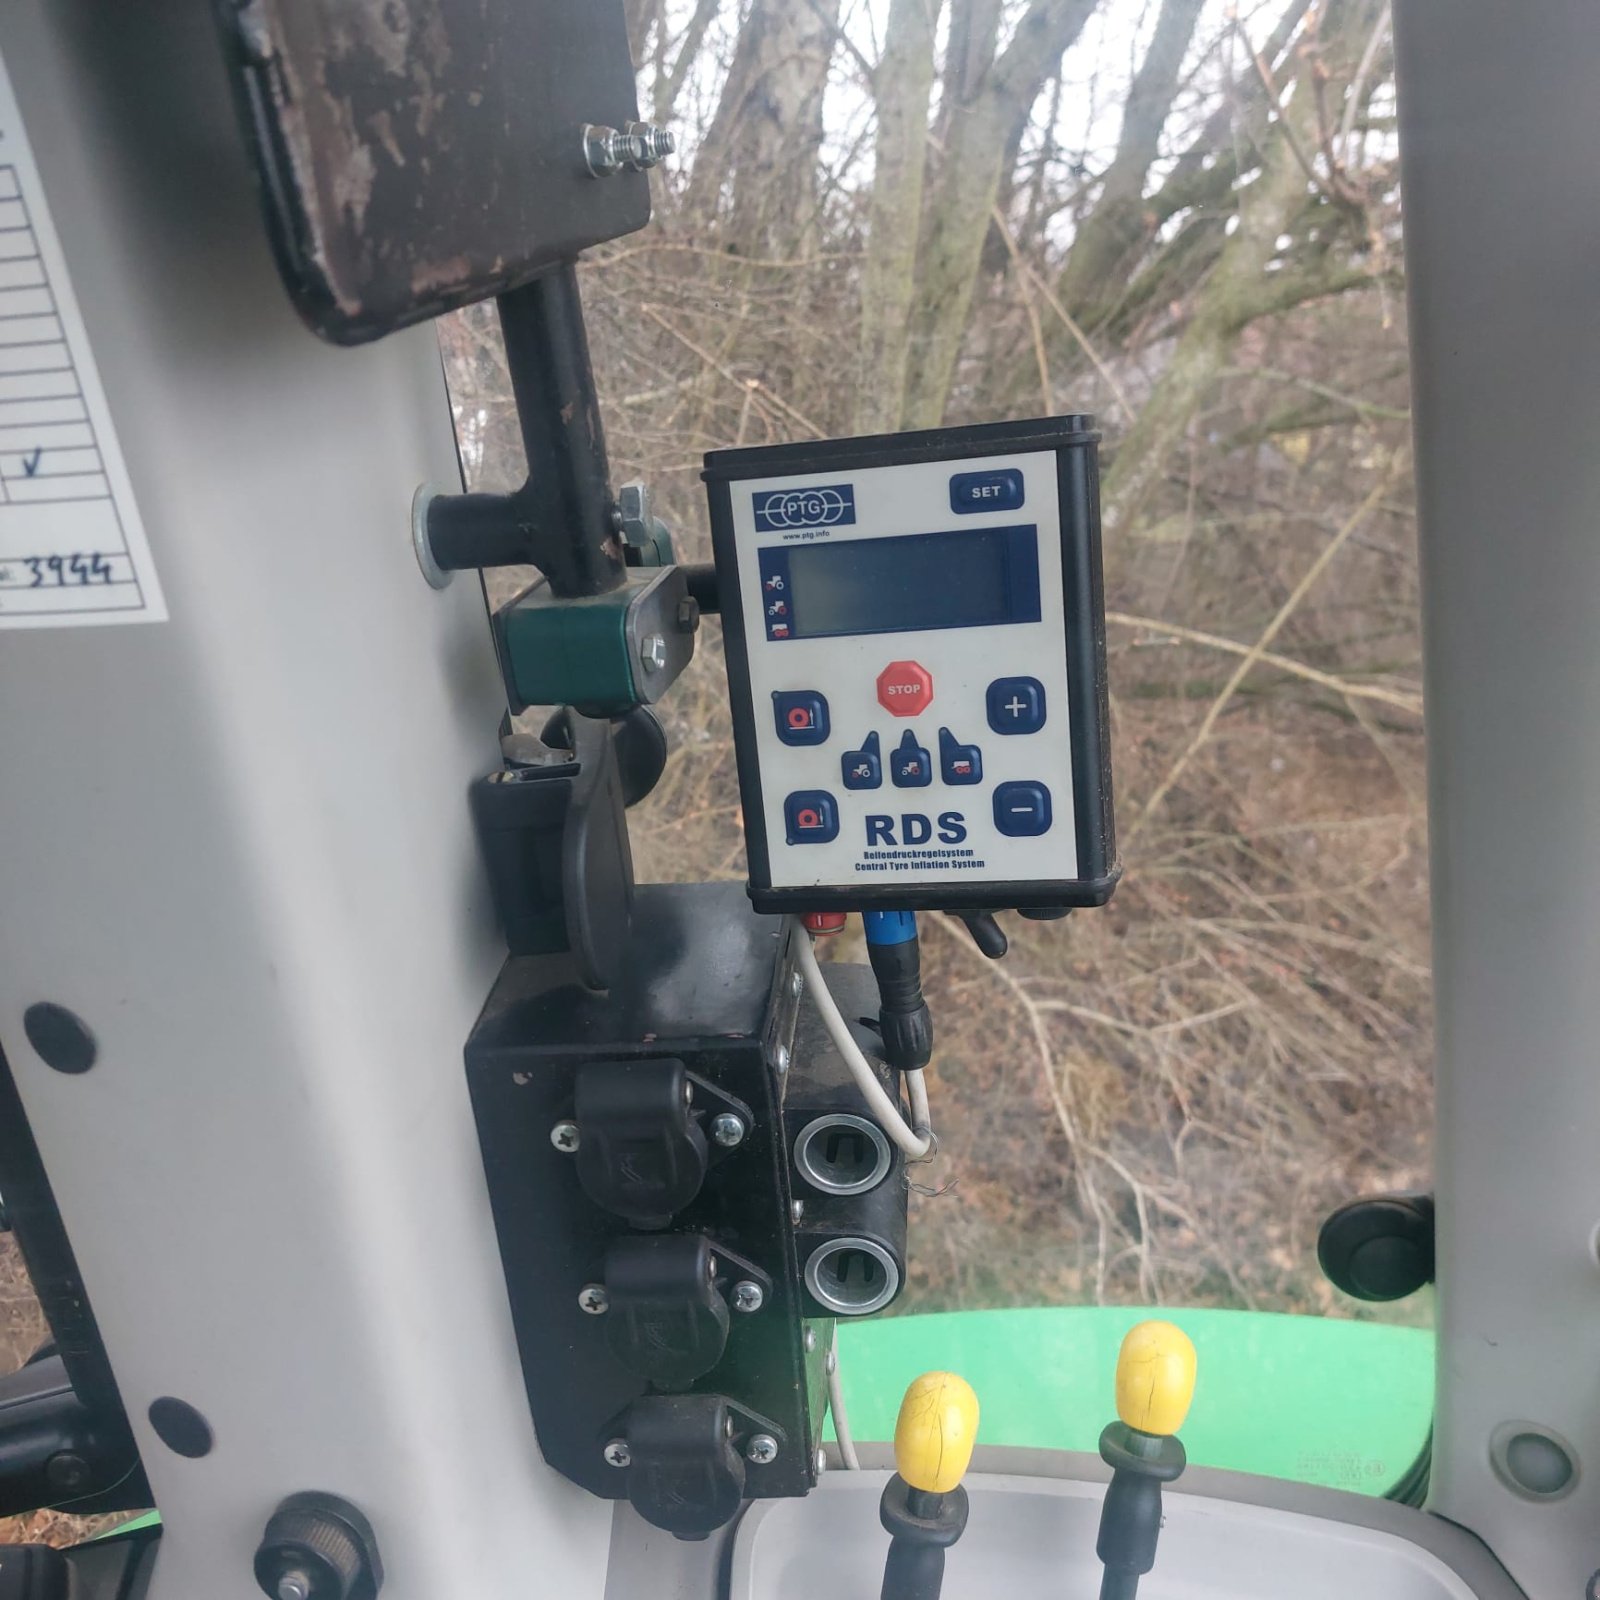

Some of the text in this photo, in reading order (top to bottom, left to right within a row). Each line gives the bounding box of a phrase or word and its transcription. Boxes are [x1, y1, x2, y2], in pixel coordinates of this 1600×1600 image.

[972, 485, 1001, 499] SET
[787, 500, 821, 516] PTG
[782, 530, 831, 542] www.ptg.info
[888, 683, 921, 696] STOP
[865, 812, 967, 846] RDS
[863, 849, 974, 860] Reifendruckregelsystem
[855, 859, 985, 871] Central Tyre Inflation System
